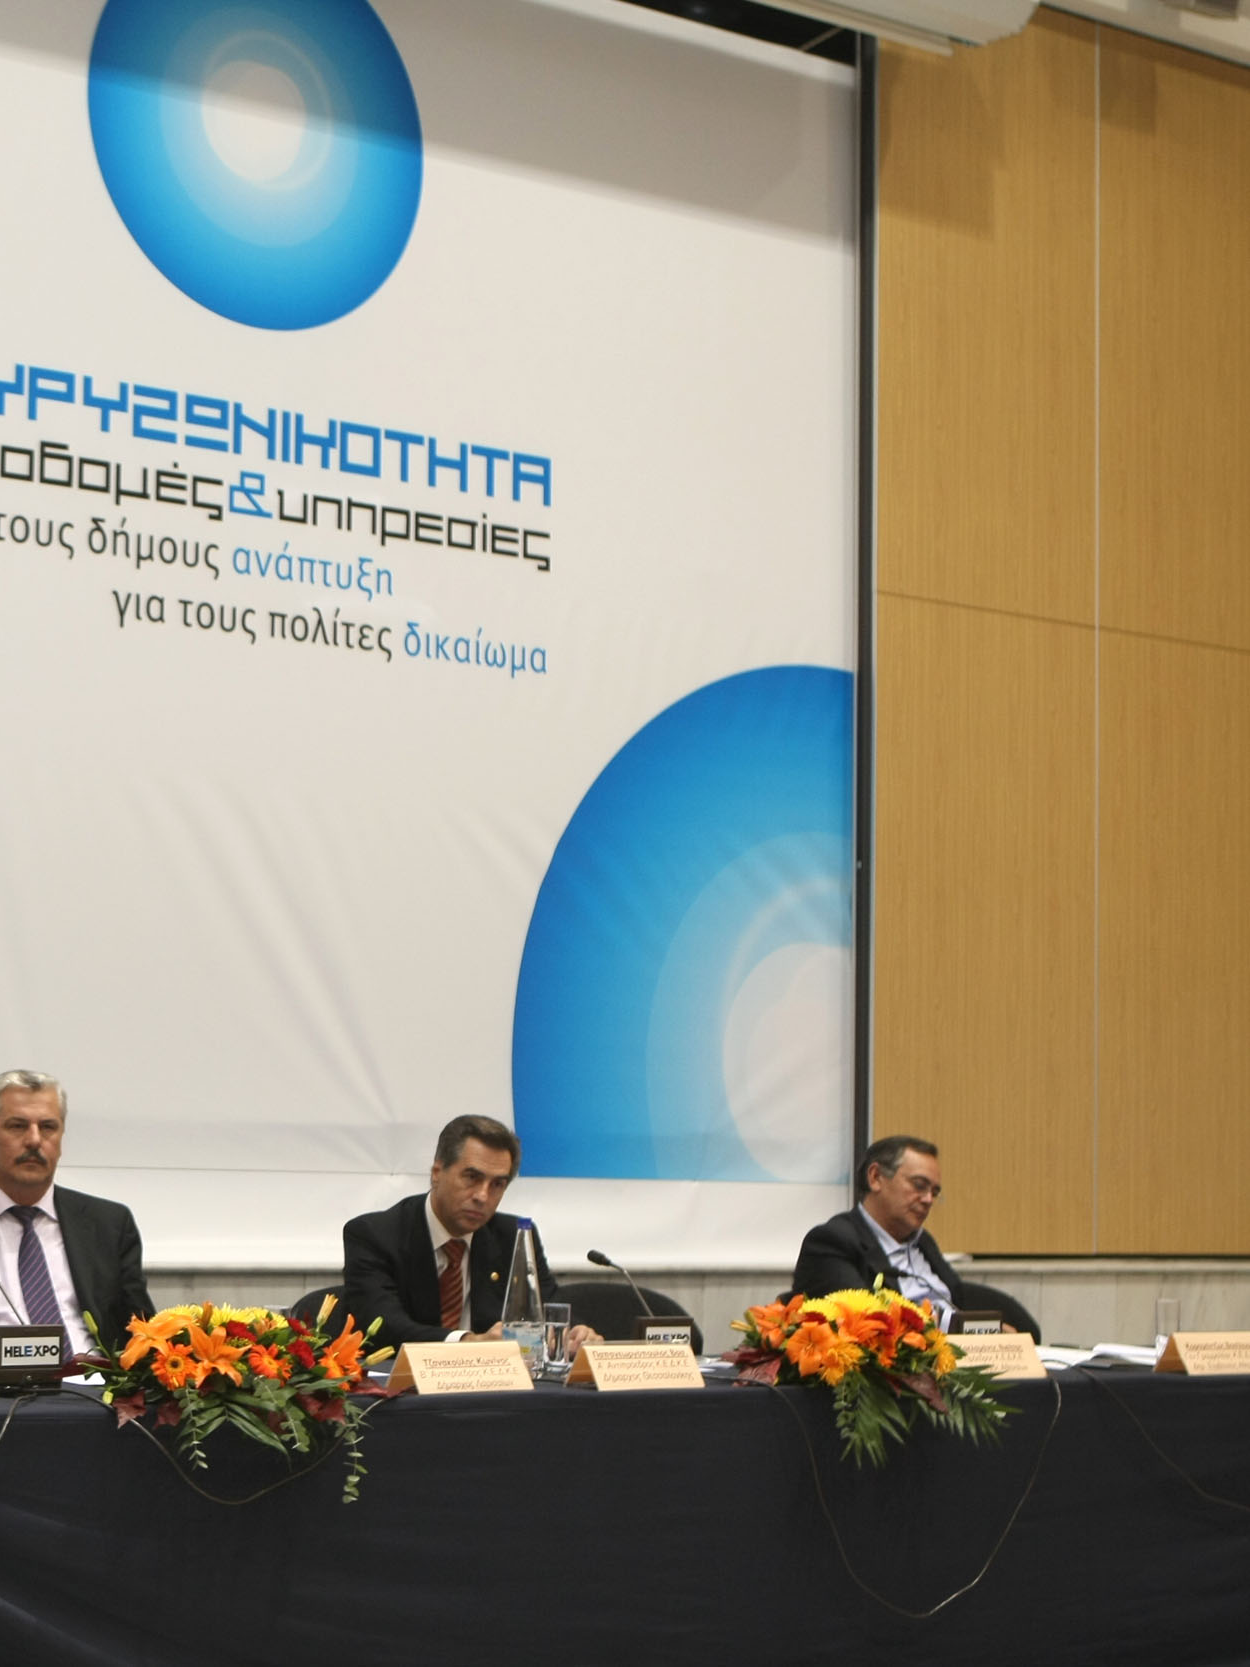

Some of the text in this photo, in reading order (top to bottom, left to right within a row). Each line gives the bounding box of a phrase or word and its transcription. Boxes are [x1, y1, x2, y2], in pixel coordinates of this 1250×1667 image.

[87, 516, 221, 580] δήμους
[232, 541, 394, 602] ανάπτυξη
[112, 588, 548, 679] για τους πολίτες δικαίωμα
[4, 1345, 60, 1358] HELEXPO
